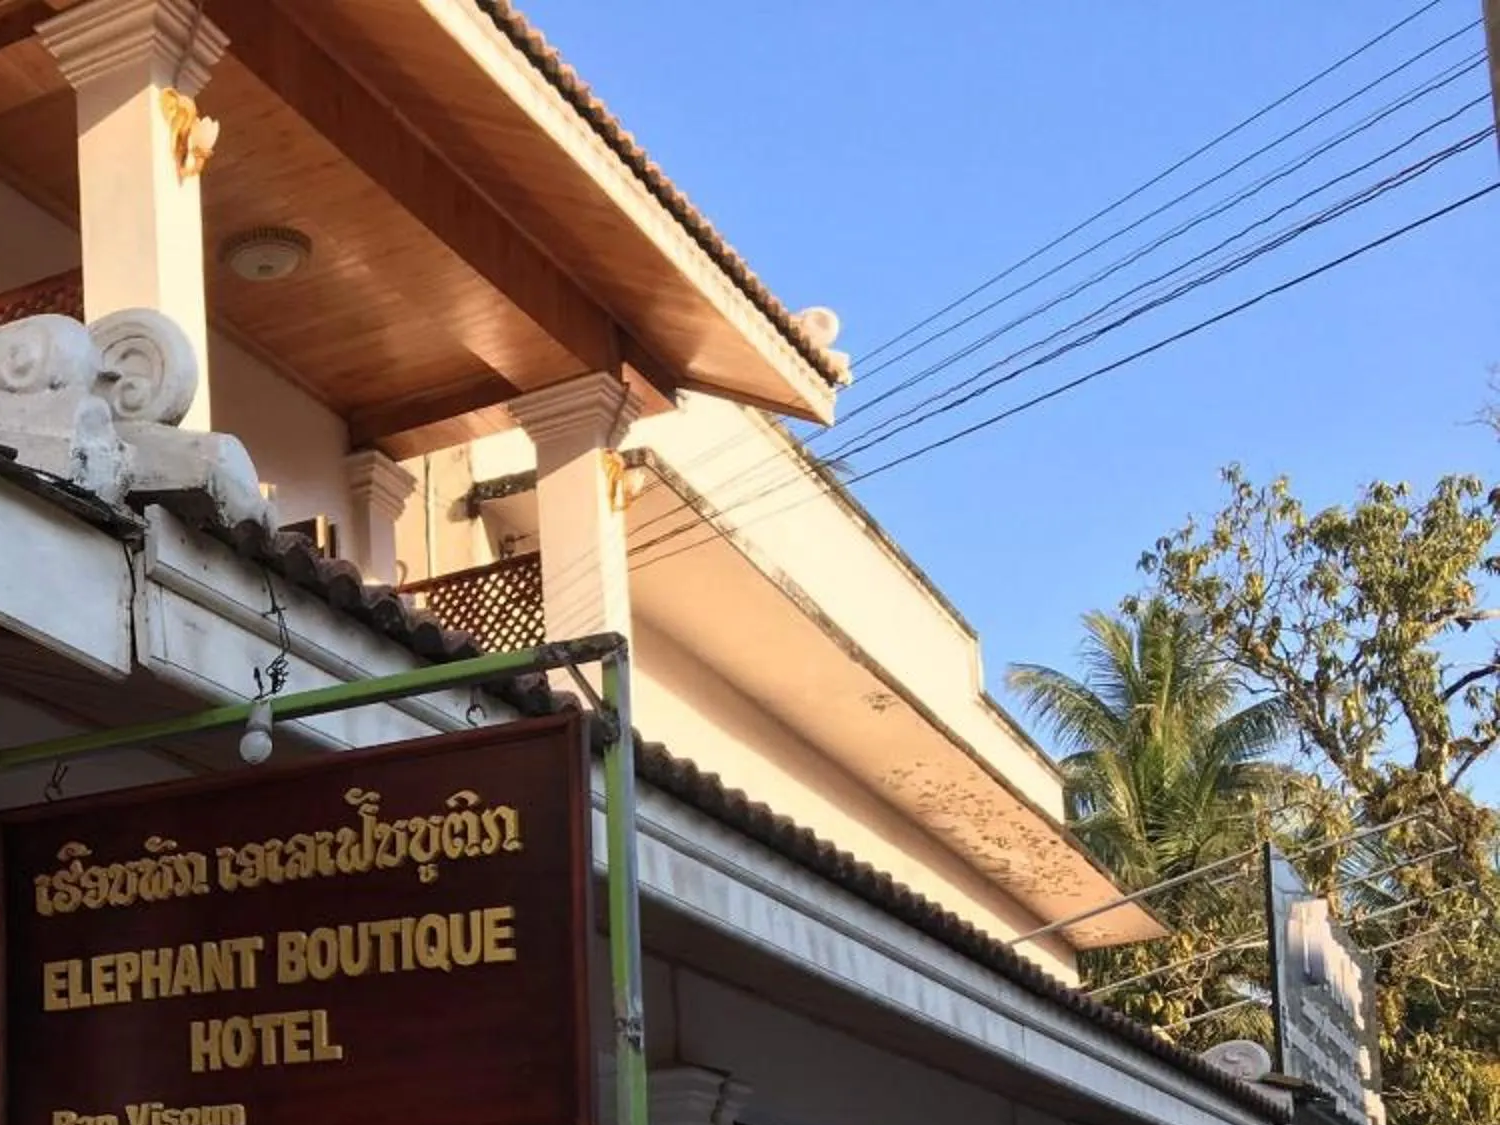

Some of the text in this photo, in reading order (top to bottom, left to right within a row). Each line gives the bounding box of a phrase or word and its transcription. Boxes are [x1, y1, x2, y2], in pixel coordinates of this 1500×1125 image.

[43, 905, 518, 1012] ELEPHANT BOUTIQUE
[191, 1009, 343, 1073] HOTEL
